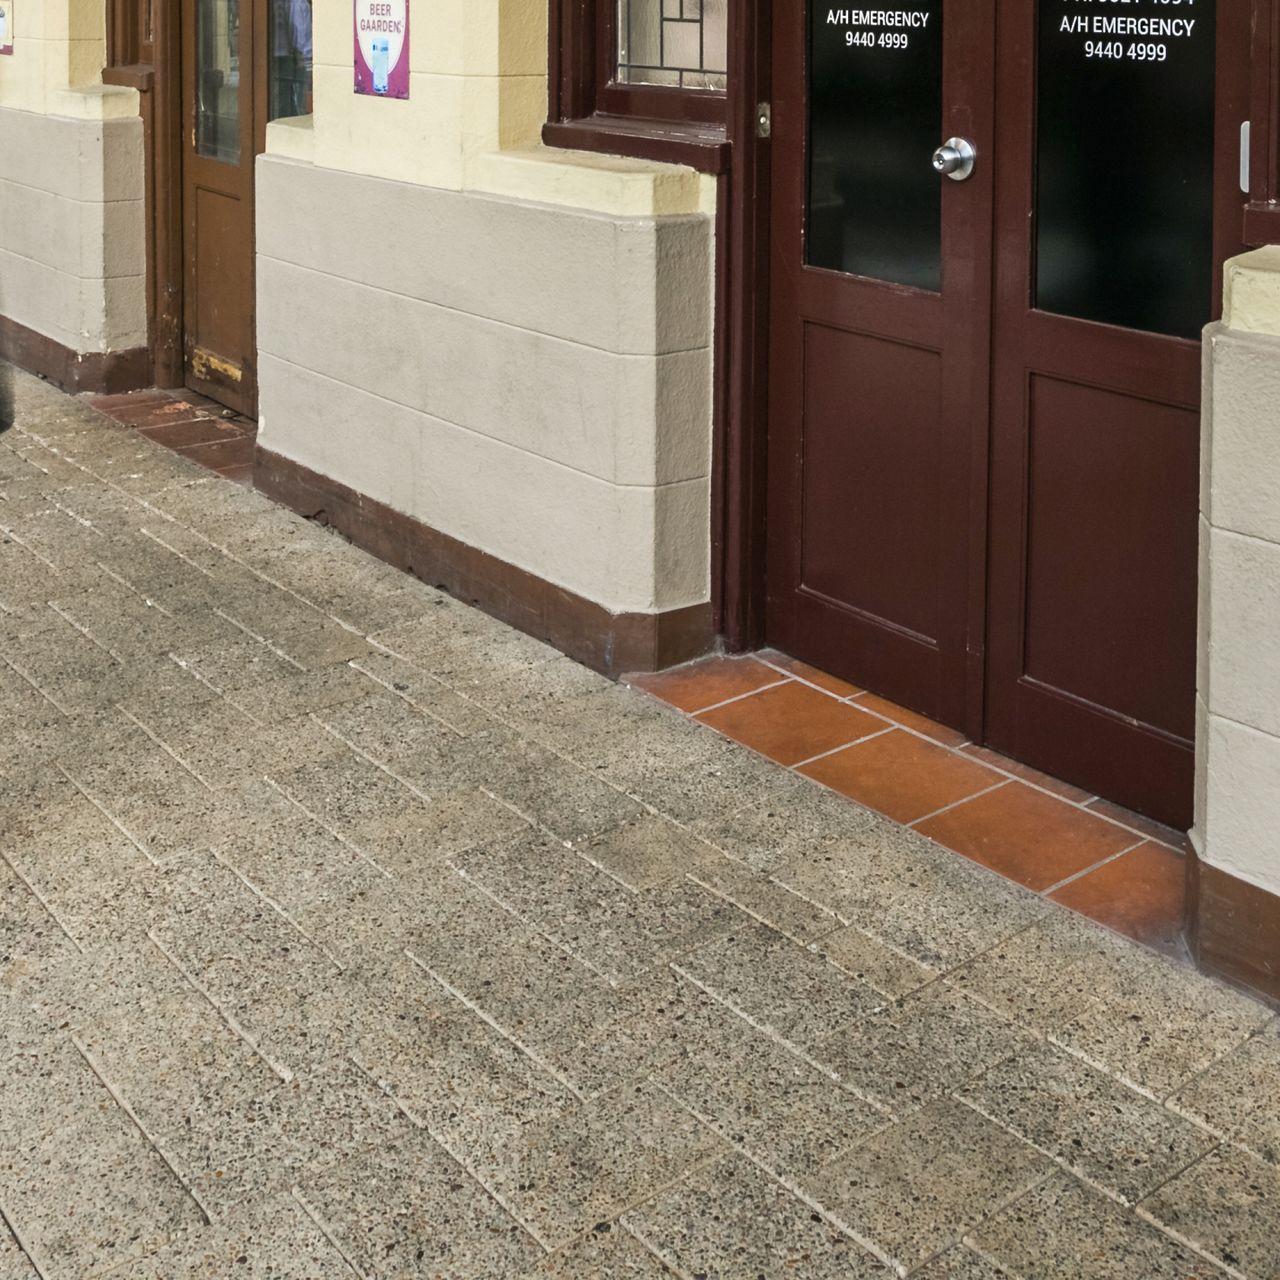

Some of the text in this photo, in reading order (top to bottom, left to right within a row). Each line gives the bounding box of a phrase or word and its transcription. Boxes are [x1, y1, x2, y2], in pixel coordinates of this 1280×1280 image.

[370, 3, 391, 17] BEER
[826, 9, 929, 28] A/H EMERGENCY
[1060, 16, 1196, 37] A/H EMERGENCY
[846, 31, 908, 49] 9440 4999
[1085, 41, 1167, 62] 9440 4999
